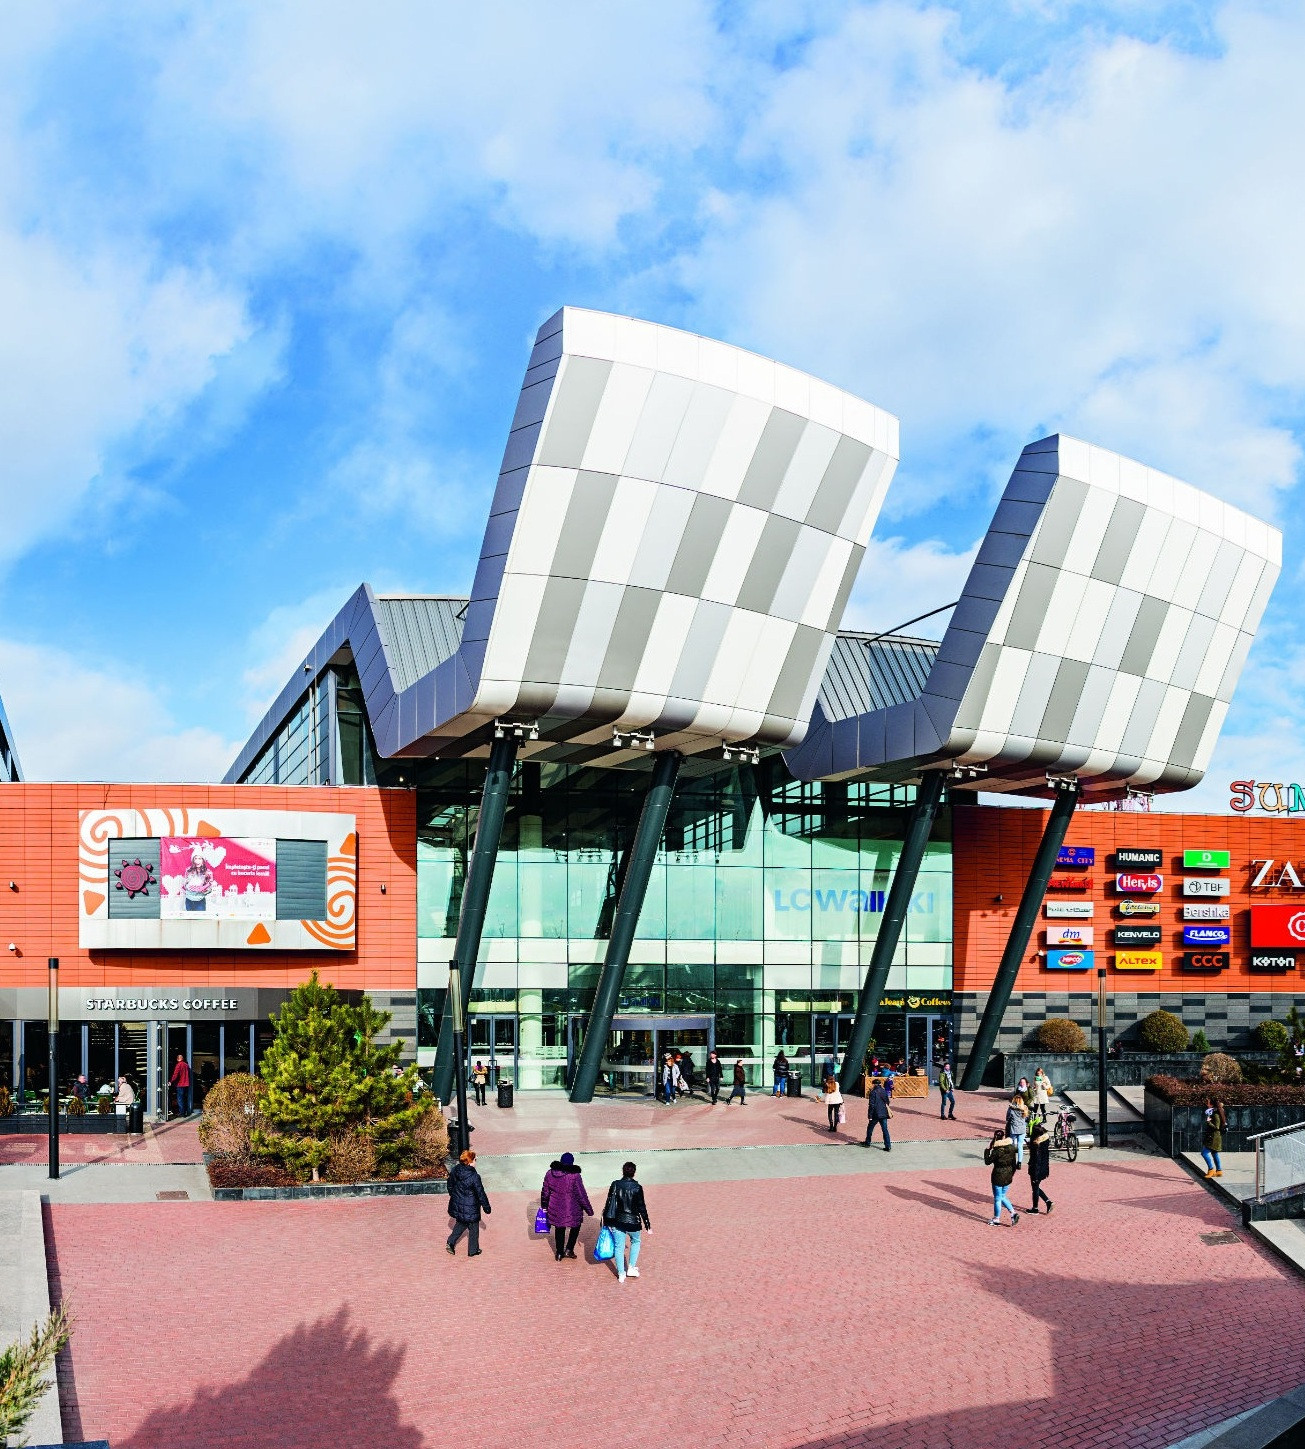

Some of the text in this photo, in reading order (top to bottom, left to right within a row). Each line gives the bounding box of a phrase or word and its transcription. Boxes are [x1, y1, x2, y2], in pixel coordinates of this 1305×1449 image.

[1118, 852, 1160, 862] HUMANIC
[1122, 875, 1158, 890] Hervis
[1184, 906, 1229, 918] Bershka
[1062, 928, 1080, 938] dm
[1191, 955, 1222, 967] CCC
[86, 999, 239, 1011] STARBUCKS COFFEE
